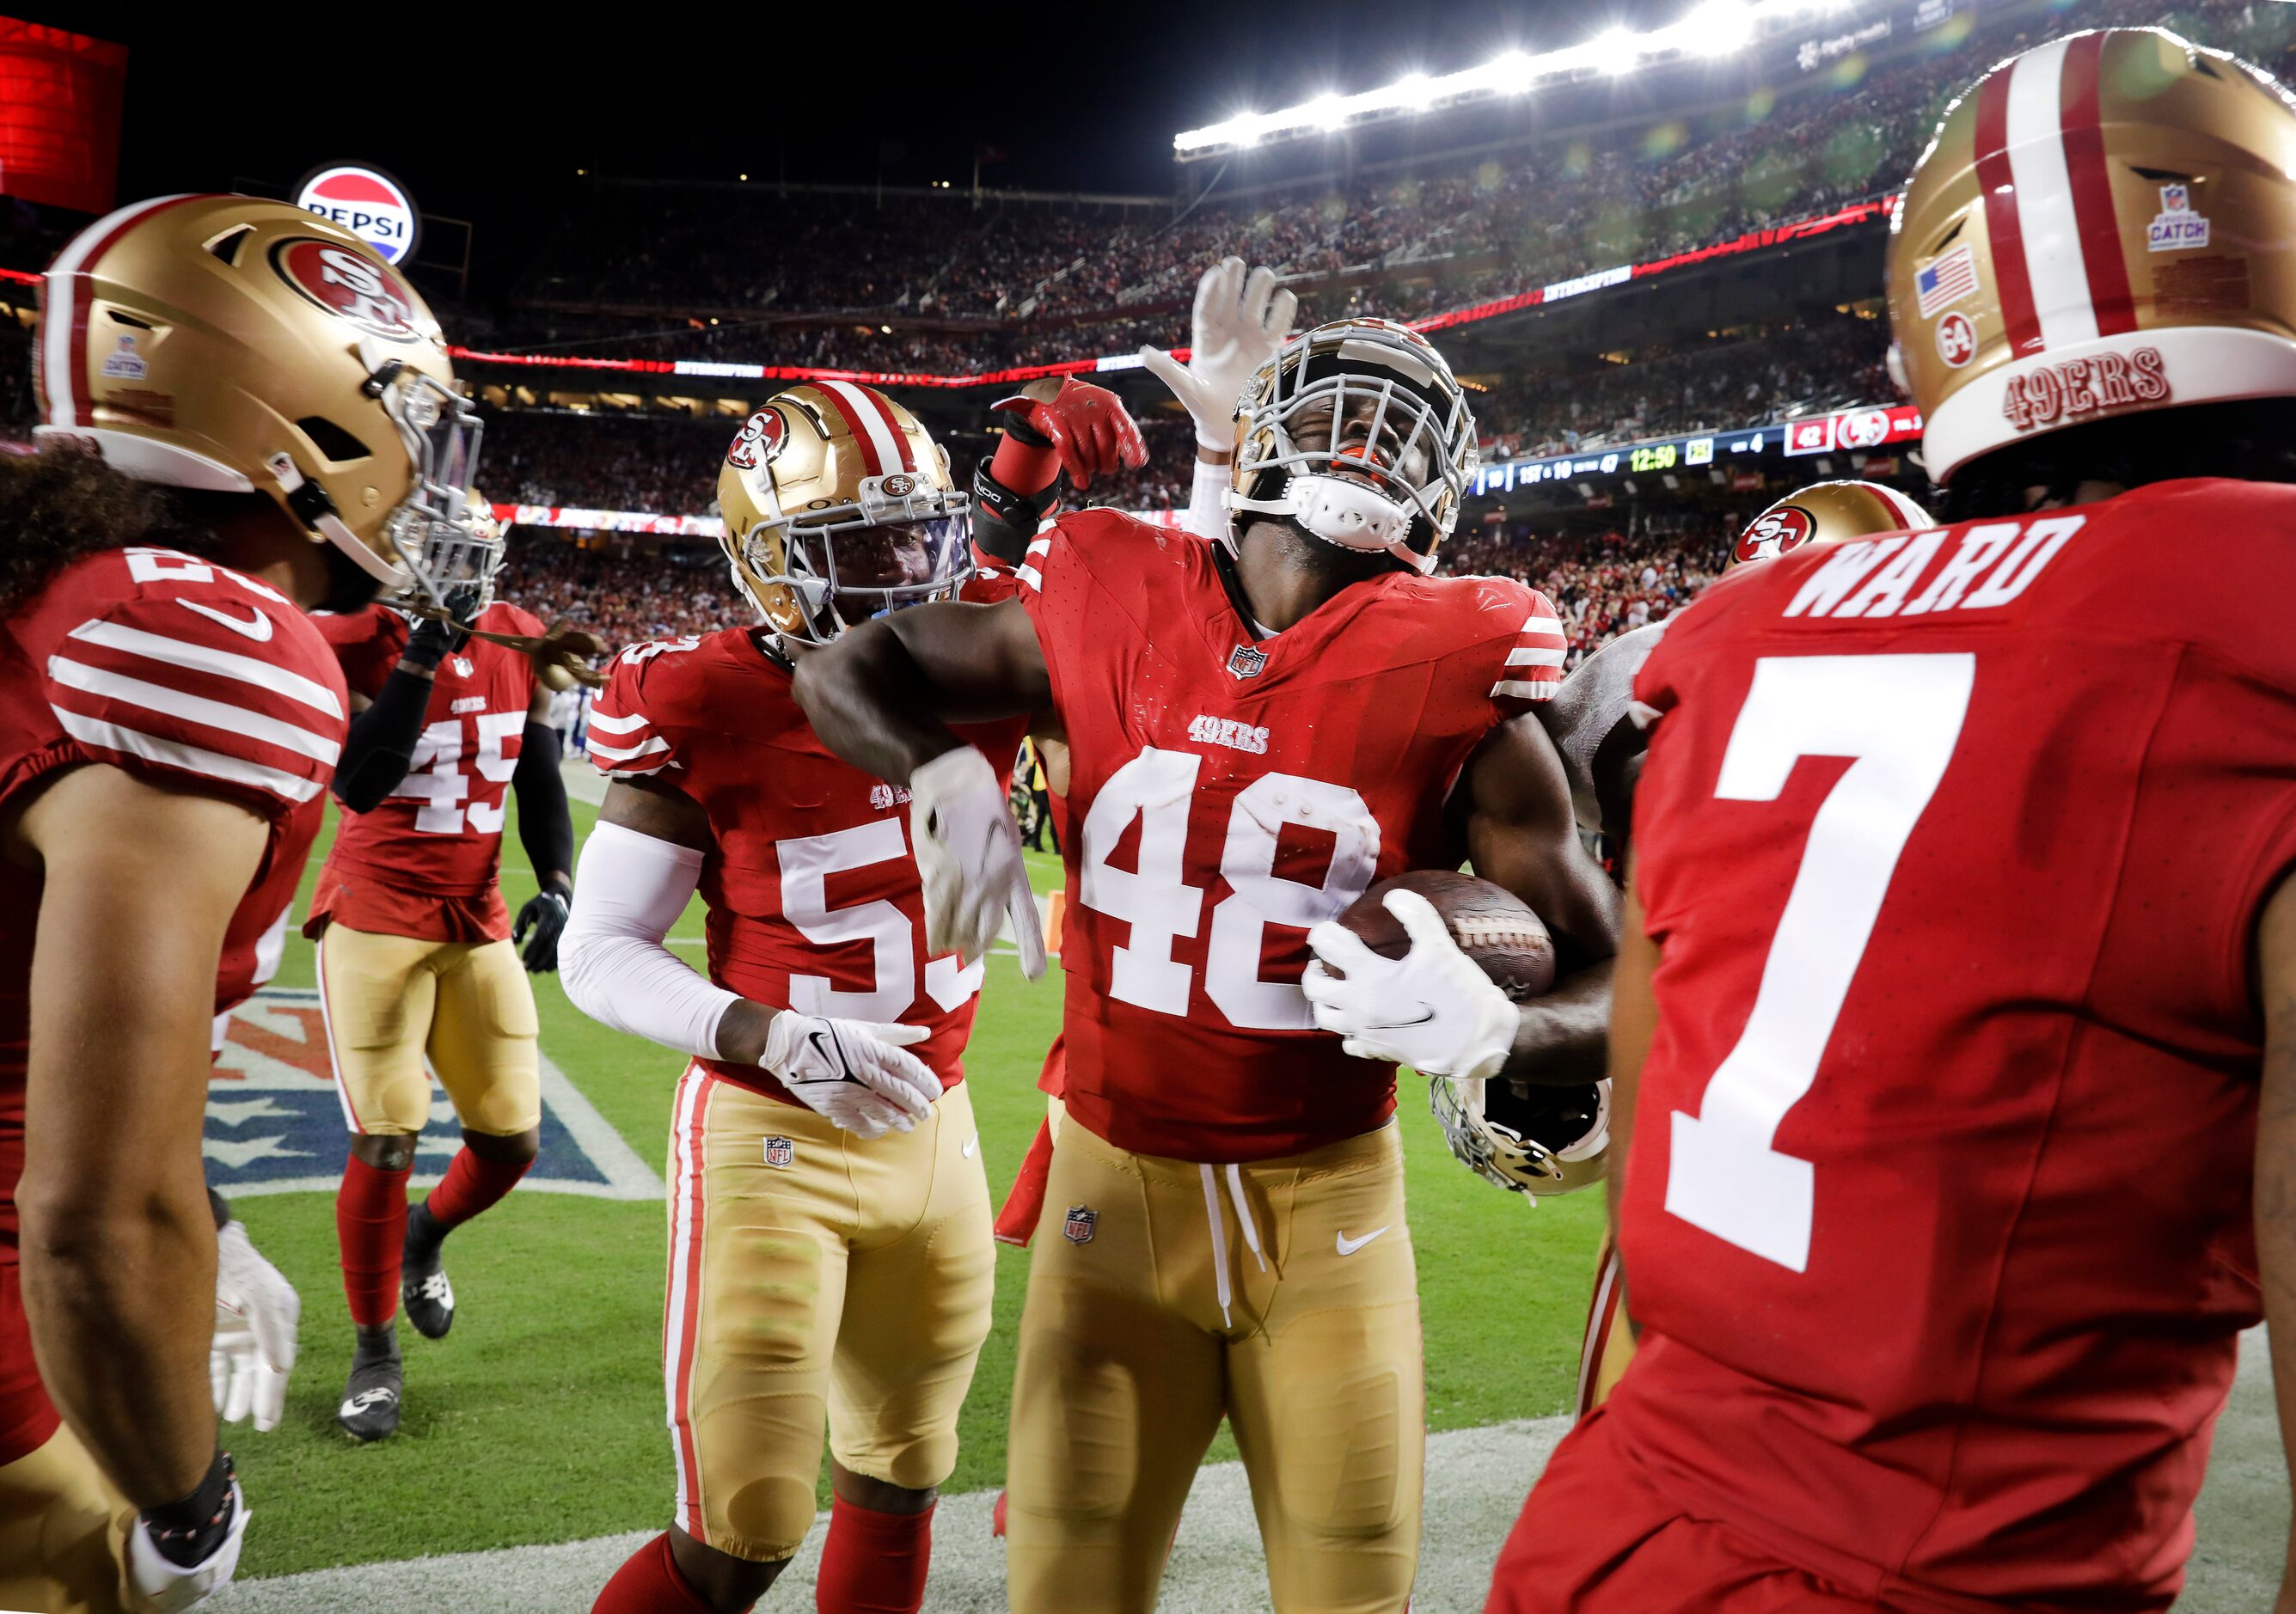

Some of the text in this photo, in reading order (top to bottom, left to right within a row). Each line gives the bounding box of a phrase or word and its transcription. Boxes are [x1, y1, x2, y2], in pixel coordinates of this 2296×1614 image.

[2151, 222, 2206, 242] CATCH
[1543, 265, 1632, 303] INTERCEPTION
[1939, 319, 1972, 359] 64
[2003, 346, 2172, 430] 49ERS
[1797, 425, 1823, 448] 42
[1630, 444, 1676, 472] 12:50
[1782, 515, 2086, 618] WARD
[1187, 714, 1270, 755] 49ERS
[389, 710, 527, 834] 45
[1080, 745, 1381, 1030] 48
[1664, 652, 1975, 1272] 7
[768, 1148, 789, 1163] NFL
